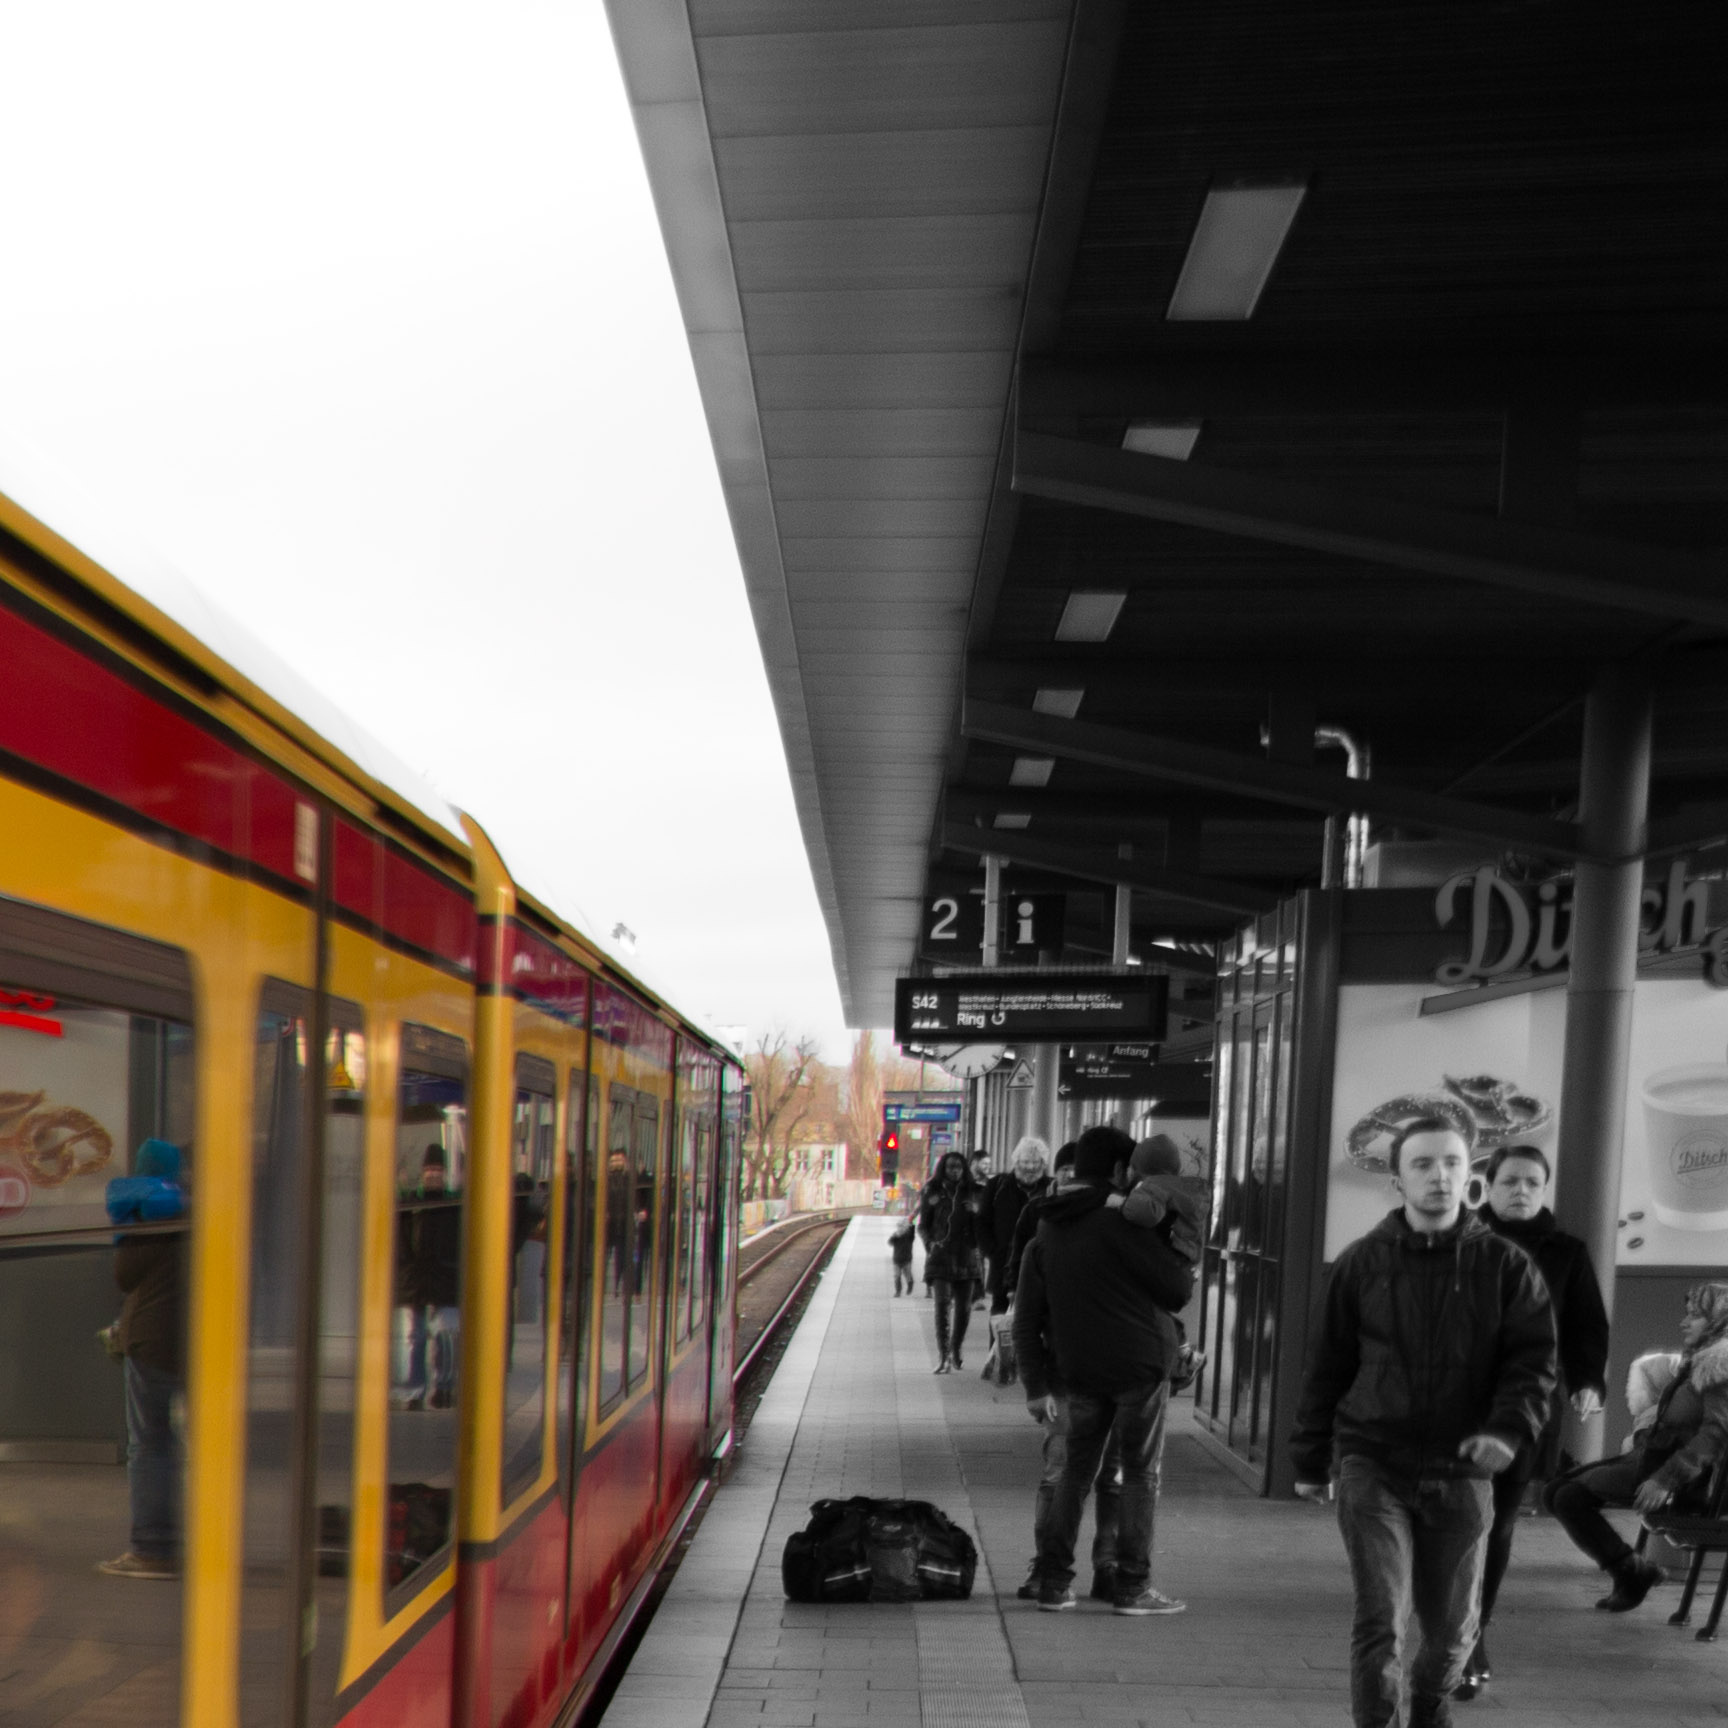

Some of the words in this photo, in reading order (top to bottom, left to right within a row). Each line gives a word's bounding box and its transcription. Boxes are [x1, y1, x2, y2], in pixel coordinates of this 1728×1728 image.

[930, 898, 958, 940] 2
[1435, 861, 1709, 985] Dich
[912, 995, 938, 1009] S42
[957, 1012, 985, 1028] Ring
[1113, 1045, 1148, 1058] Anfang
